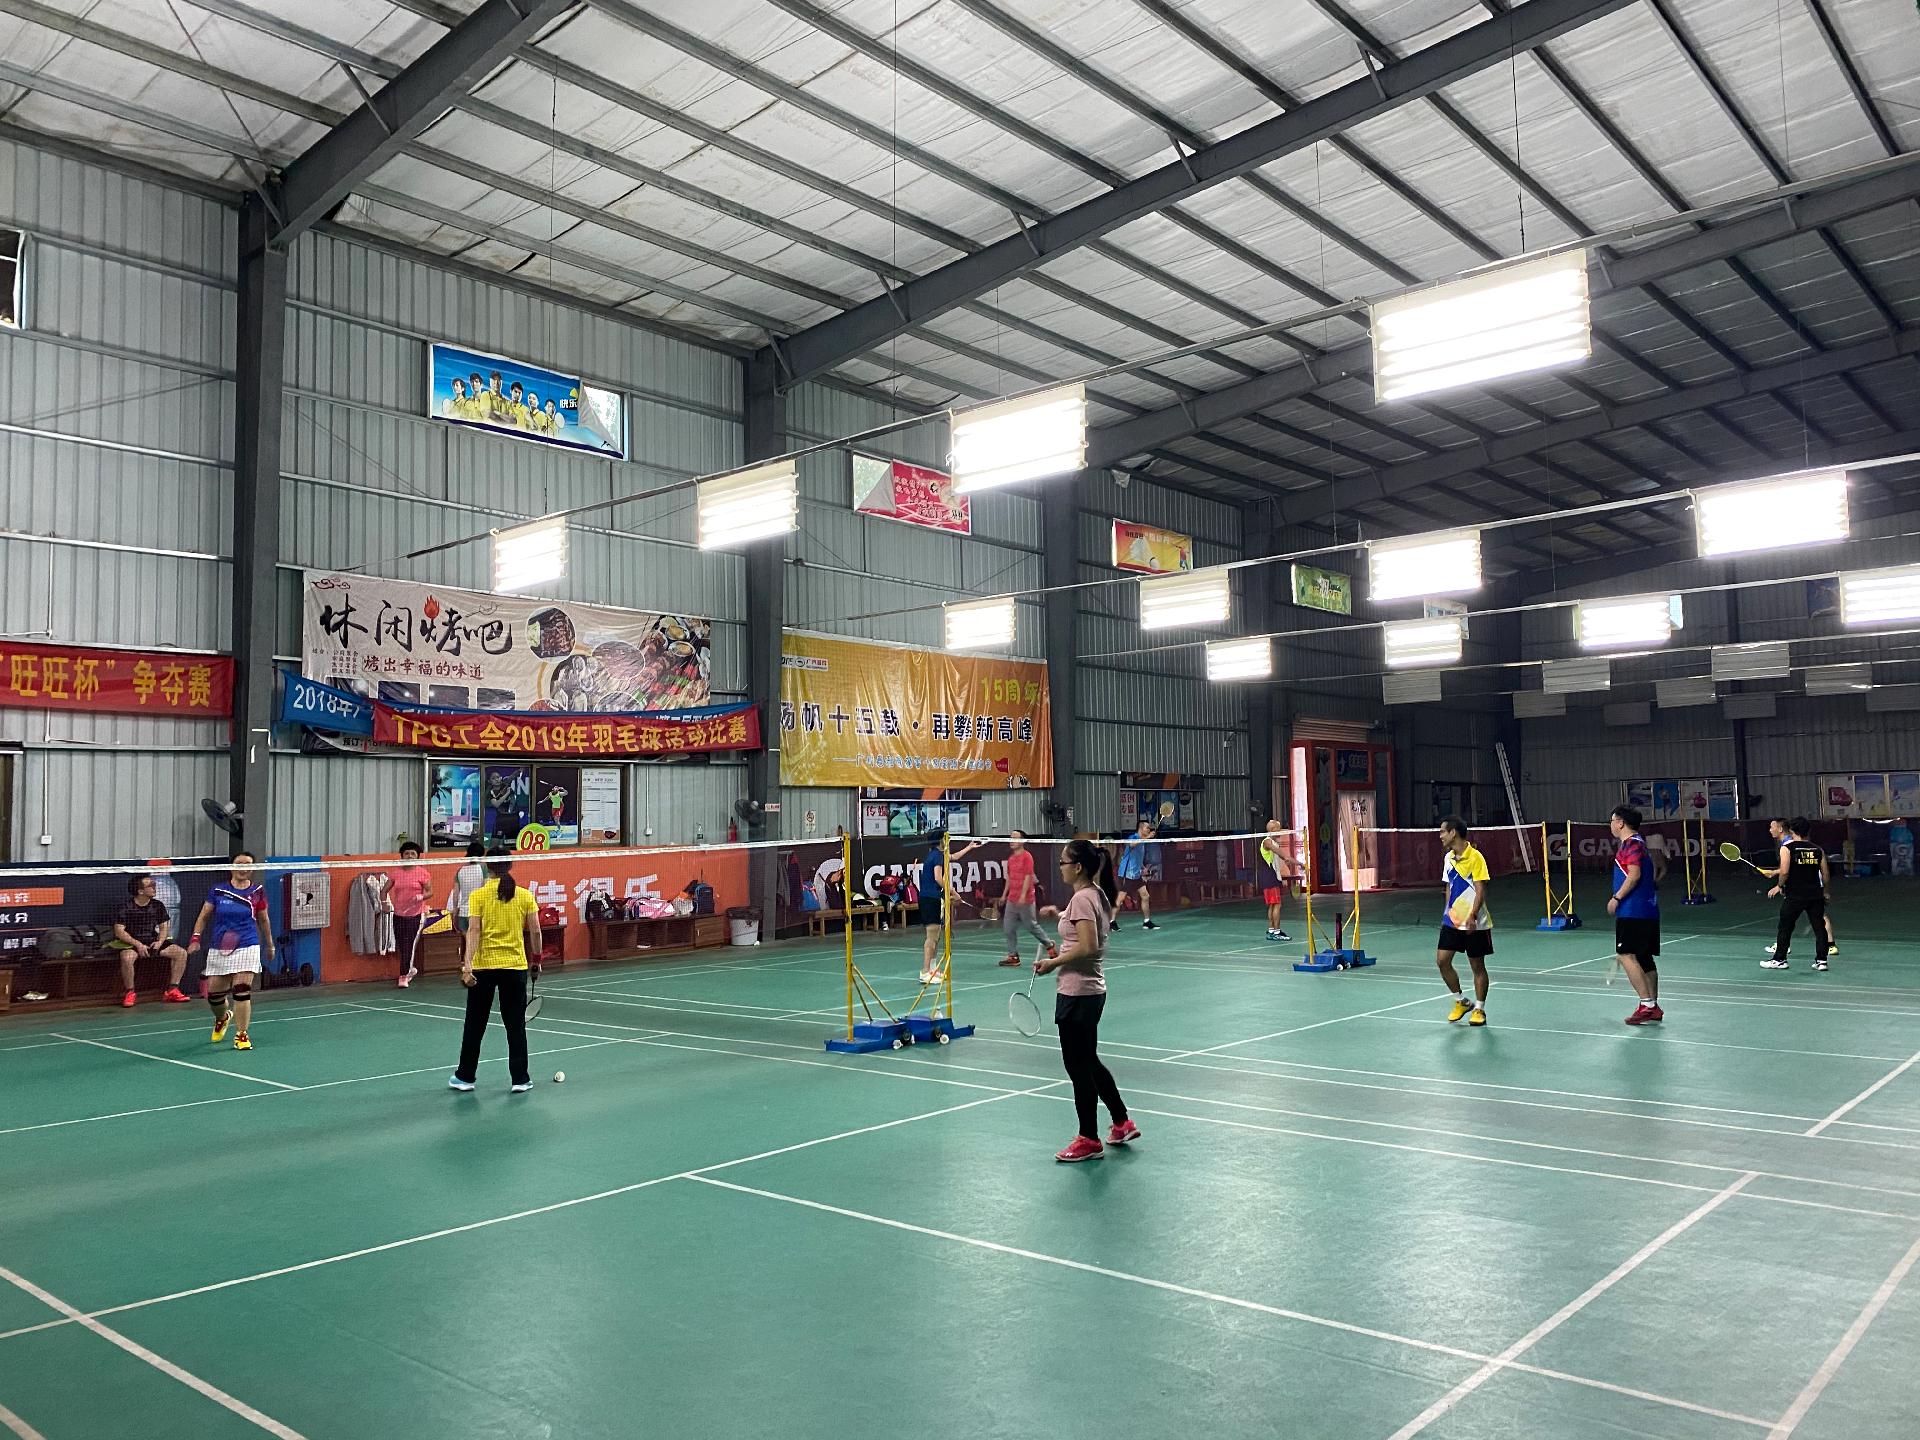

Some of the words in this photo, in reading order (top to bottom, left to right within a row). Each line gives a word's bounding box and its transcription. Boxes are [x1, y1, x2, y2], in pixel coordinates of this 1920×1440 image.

[320, 593, 513, 656] 休闲烤吧
[363, 654, 484, 680] 烤出幸福的味道
[981, 677, 1040, 705] 15周年
[391, 714, 746, 752] TPG工会2019年羽毛球活动比赛
[520, 830, 546, 850] 08
